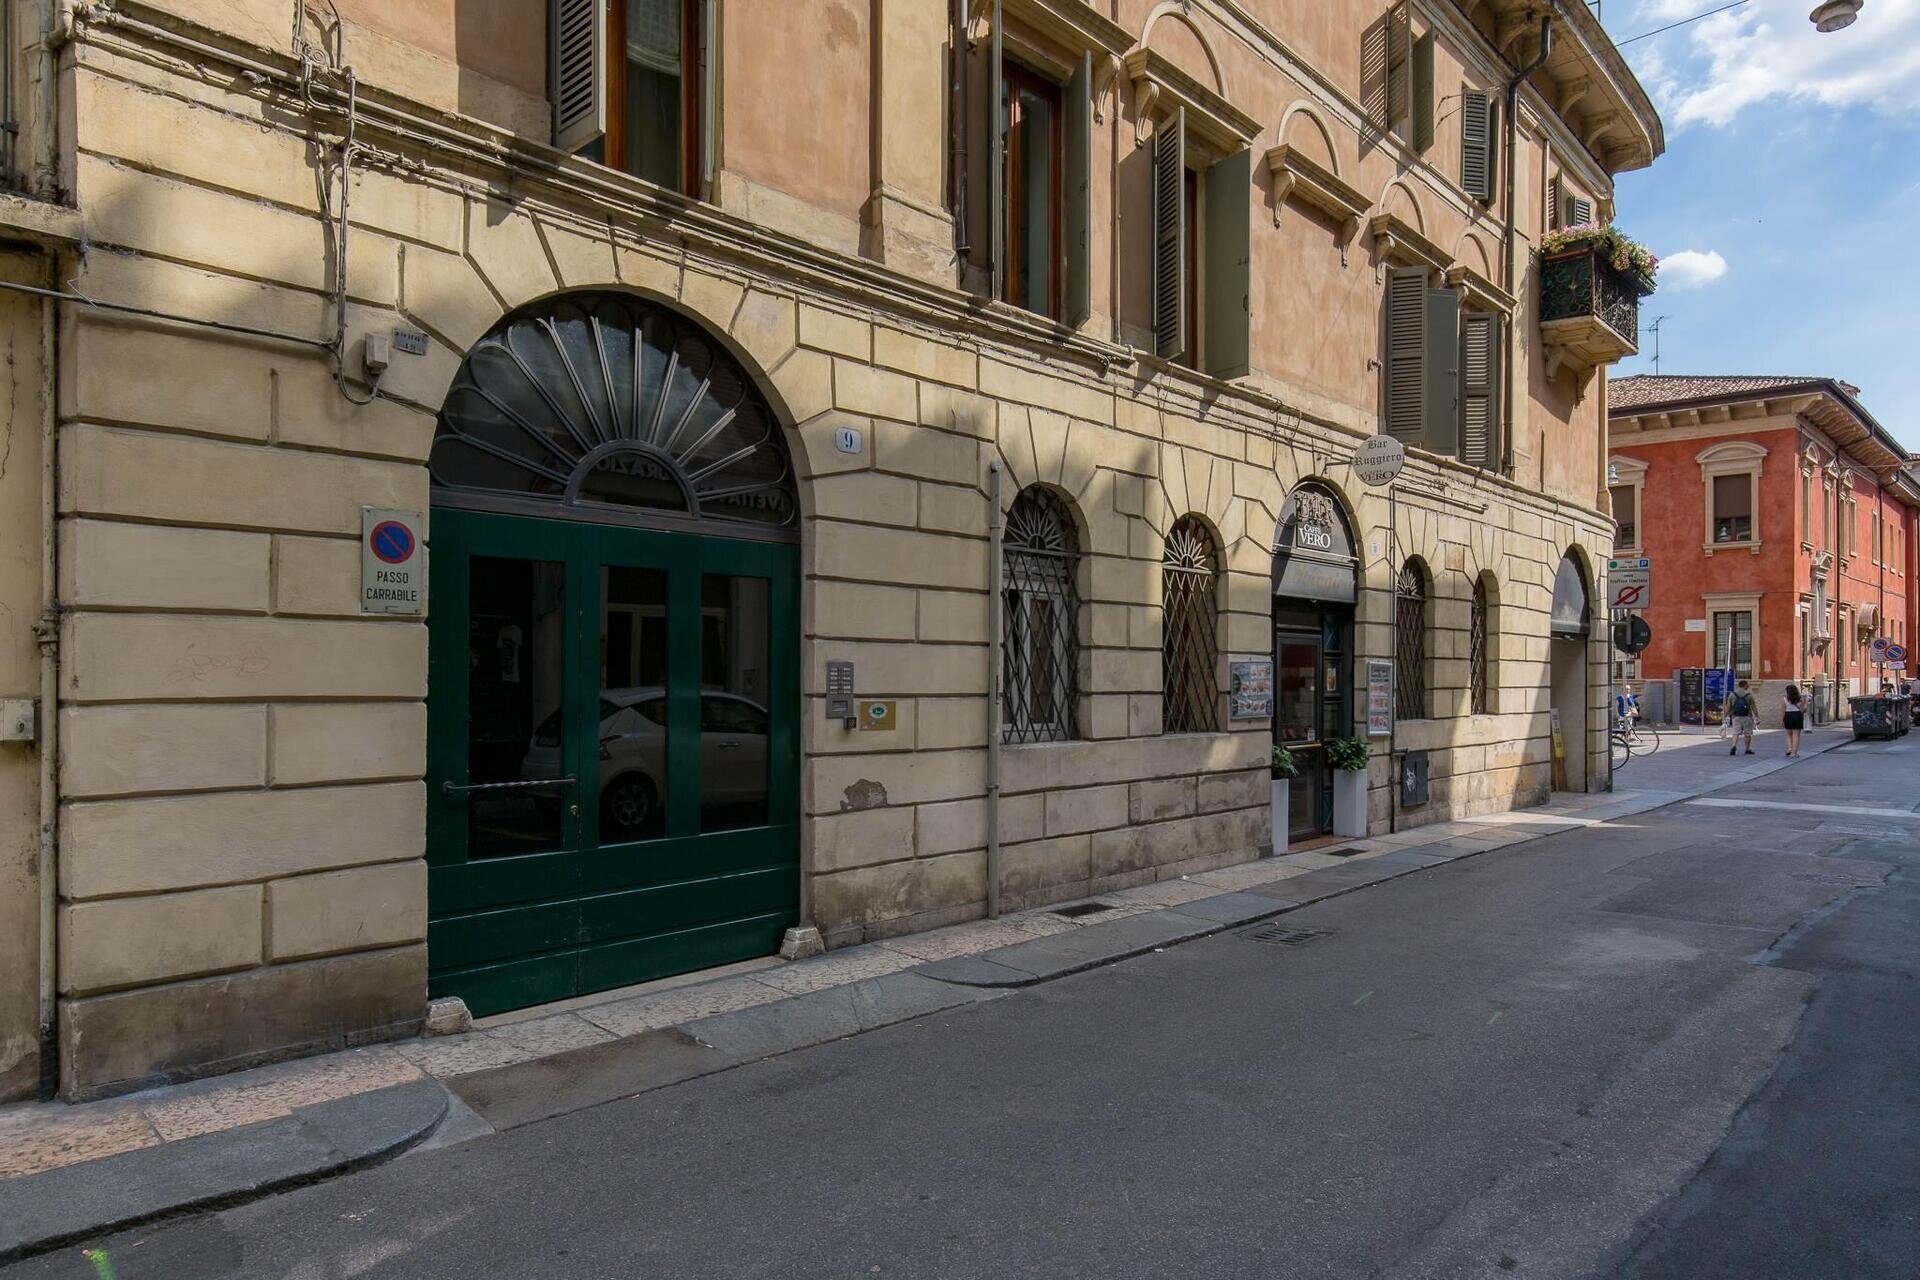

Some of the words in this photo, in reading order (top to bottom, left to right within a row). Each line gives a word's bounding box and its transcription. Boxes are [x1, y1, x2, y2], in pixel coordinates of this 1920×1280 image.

[844, 431, 853, 449] 9
[1367, 439, 1388, 449] Bar
[1354, 454, 1402, 466] Ruggiero
[1360, 471, 1394, 481] VERO
[1298, 527, 1331, 549] VERO
[376, 570, 409, 584] PASSO
[366, 587, 417, 602] CARRABILE
